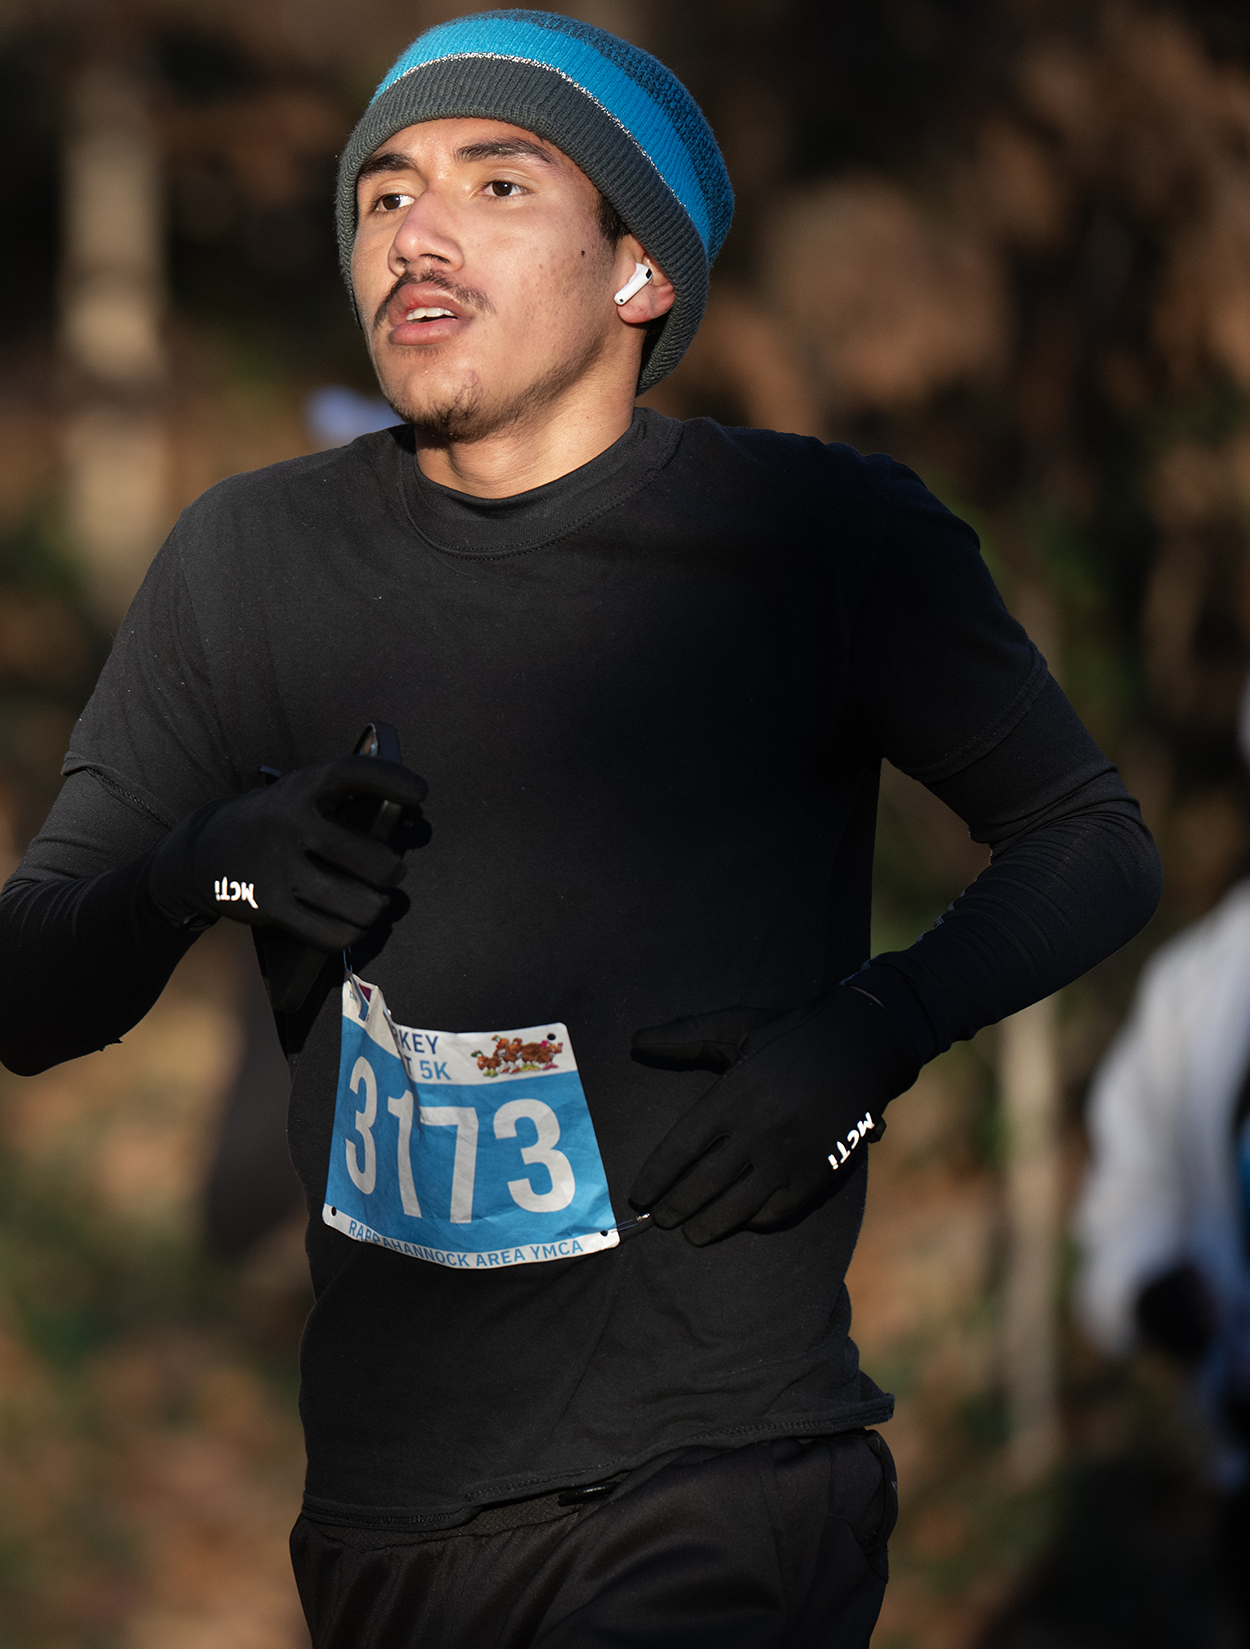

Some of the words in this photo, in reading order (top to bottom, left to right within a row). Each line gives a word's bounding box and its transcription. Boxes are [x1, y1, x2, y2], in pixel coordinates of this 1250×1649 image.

[419, 1060, 452, 1081] 5K
[345, 1056, 576, 1224] 3173
[348, 1220, 471, 1267] RAPPAHANNOCK
[476, 1248, 526, 1267] AREA
[530, 1239, 584, 1260] YMCA
